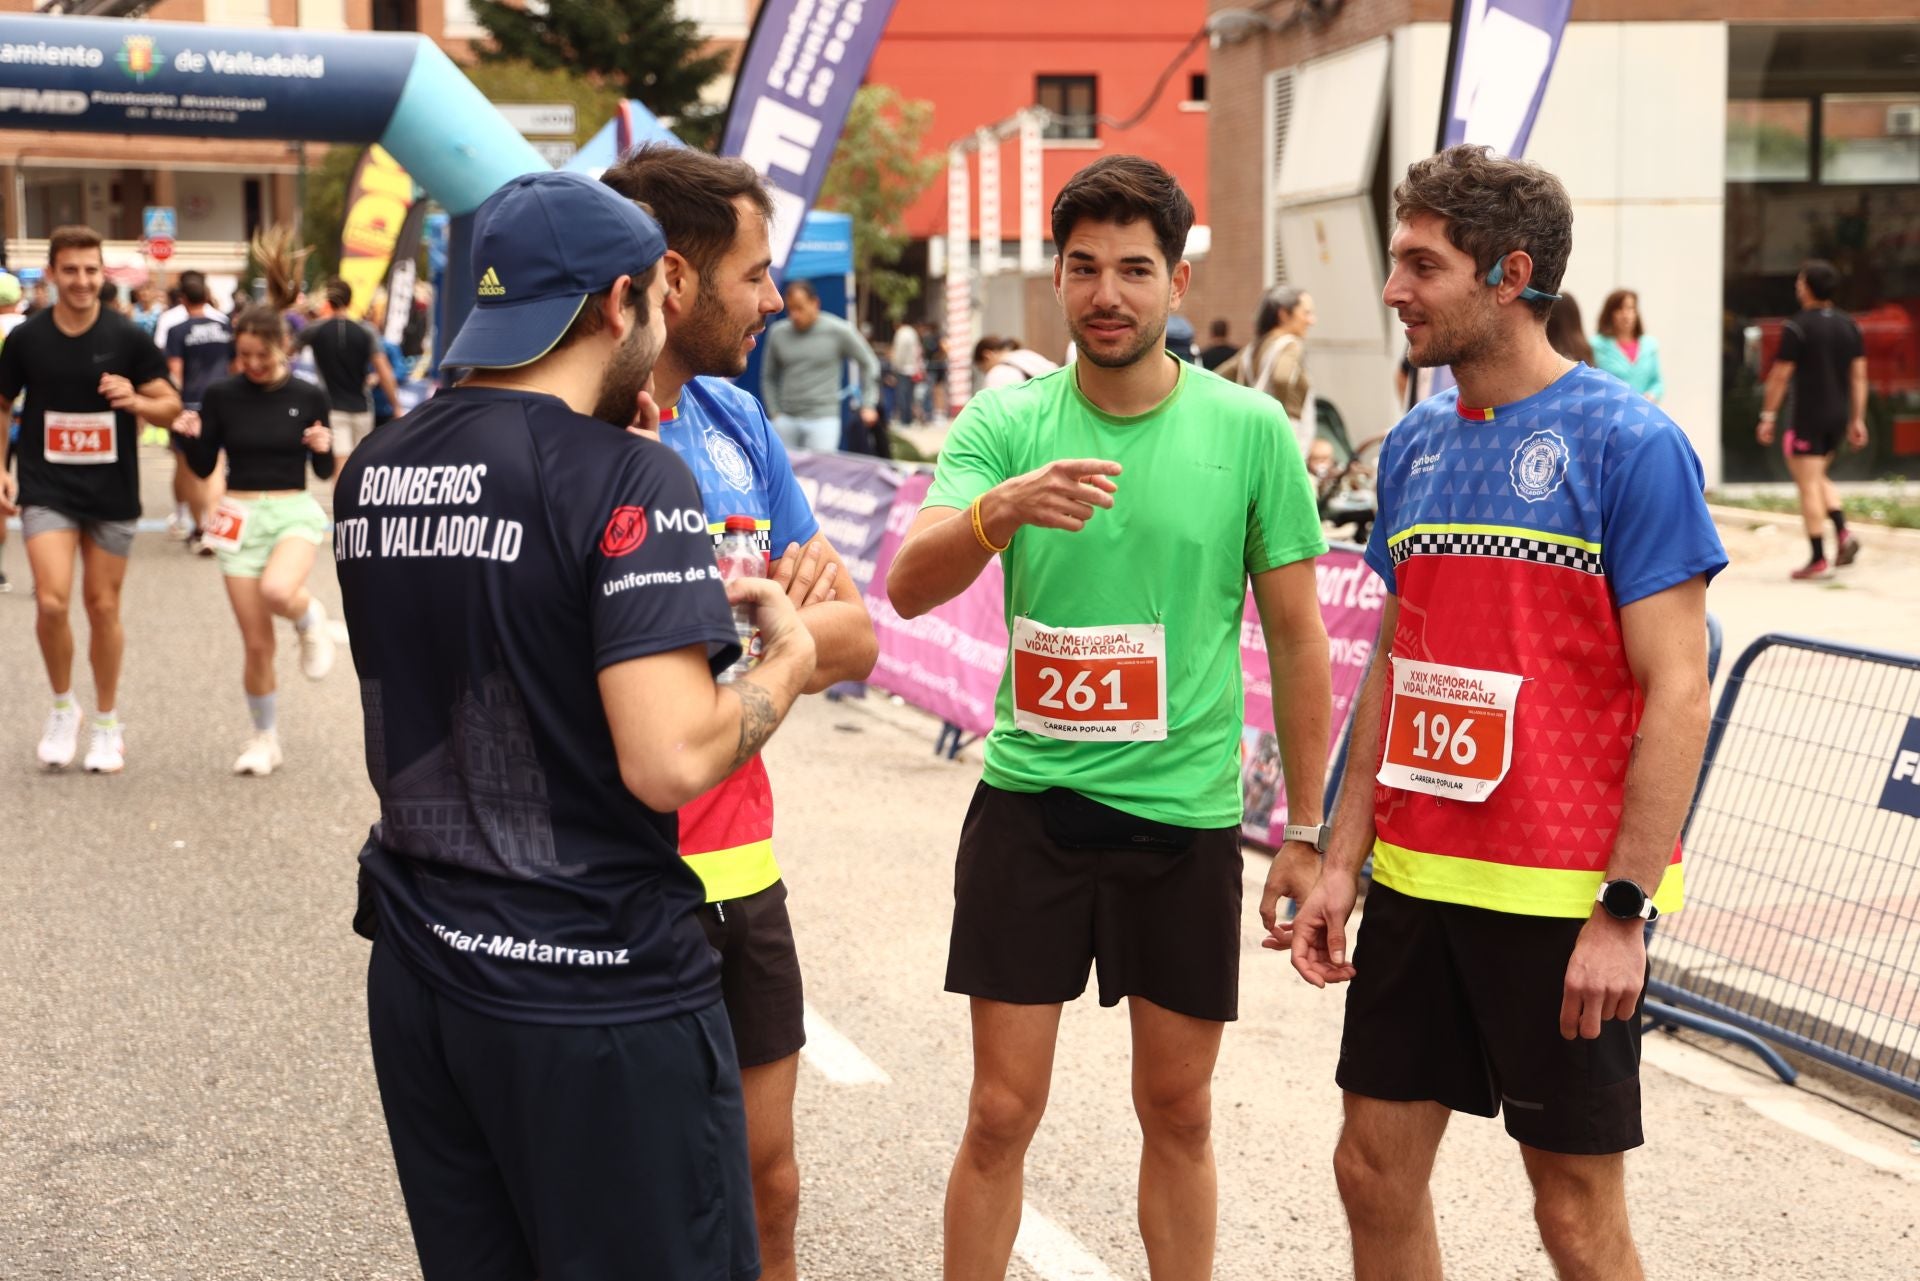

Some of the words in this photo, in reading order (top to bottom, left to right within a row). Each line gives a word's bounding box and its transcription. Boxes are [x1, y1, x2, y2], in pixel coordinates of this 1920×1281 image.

[823, 0, 868, 64] Dep
[0, 41, 103, 67] amiento
[174, 49, 206, 73] de
[207, 50, 325, 79] Valladolid
[478, 285, 506, 296] adidas
[59, 430, 101, 452] 194
[358, 464, 487, 506] BOMBEROS
[655, 508, 708, 533] MO
[335, 517, 372, 562] AYTO.
[381, 515, 524, 562] VALLADOLID
[603, 572, 682, 596] Uniformes
[685, 567, 706, 581] de
[708, 565, 722, 580] B
[1025, 639, 1144, 656] VIDAL-MATARRANZ
[1035, 631, 1058, 642] XXIX
[1063, 633, 1130, 645] MEMORIAL
[1038, 667, 1128, 711] 261
[1403, 681, 1496, 705] VIDAL-MATARRANZ
[1410, 670, 1427, 683] XXIX
[1430, 674, 1484, 691] MEMORIAL
[1044, 721, 1077, 732] CARRERA
[1080, 723, 1117, 732] POPULAR
[1412, 711, 1477, 765] 196
[1410, 773, 1436, 785] CARRERA
[1436, 779, 1463, 790] POPULAR
[426, 924, 630, 965] idal-Matarranz
